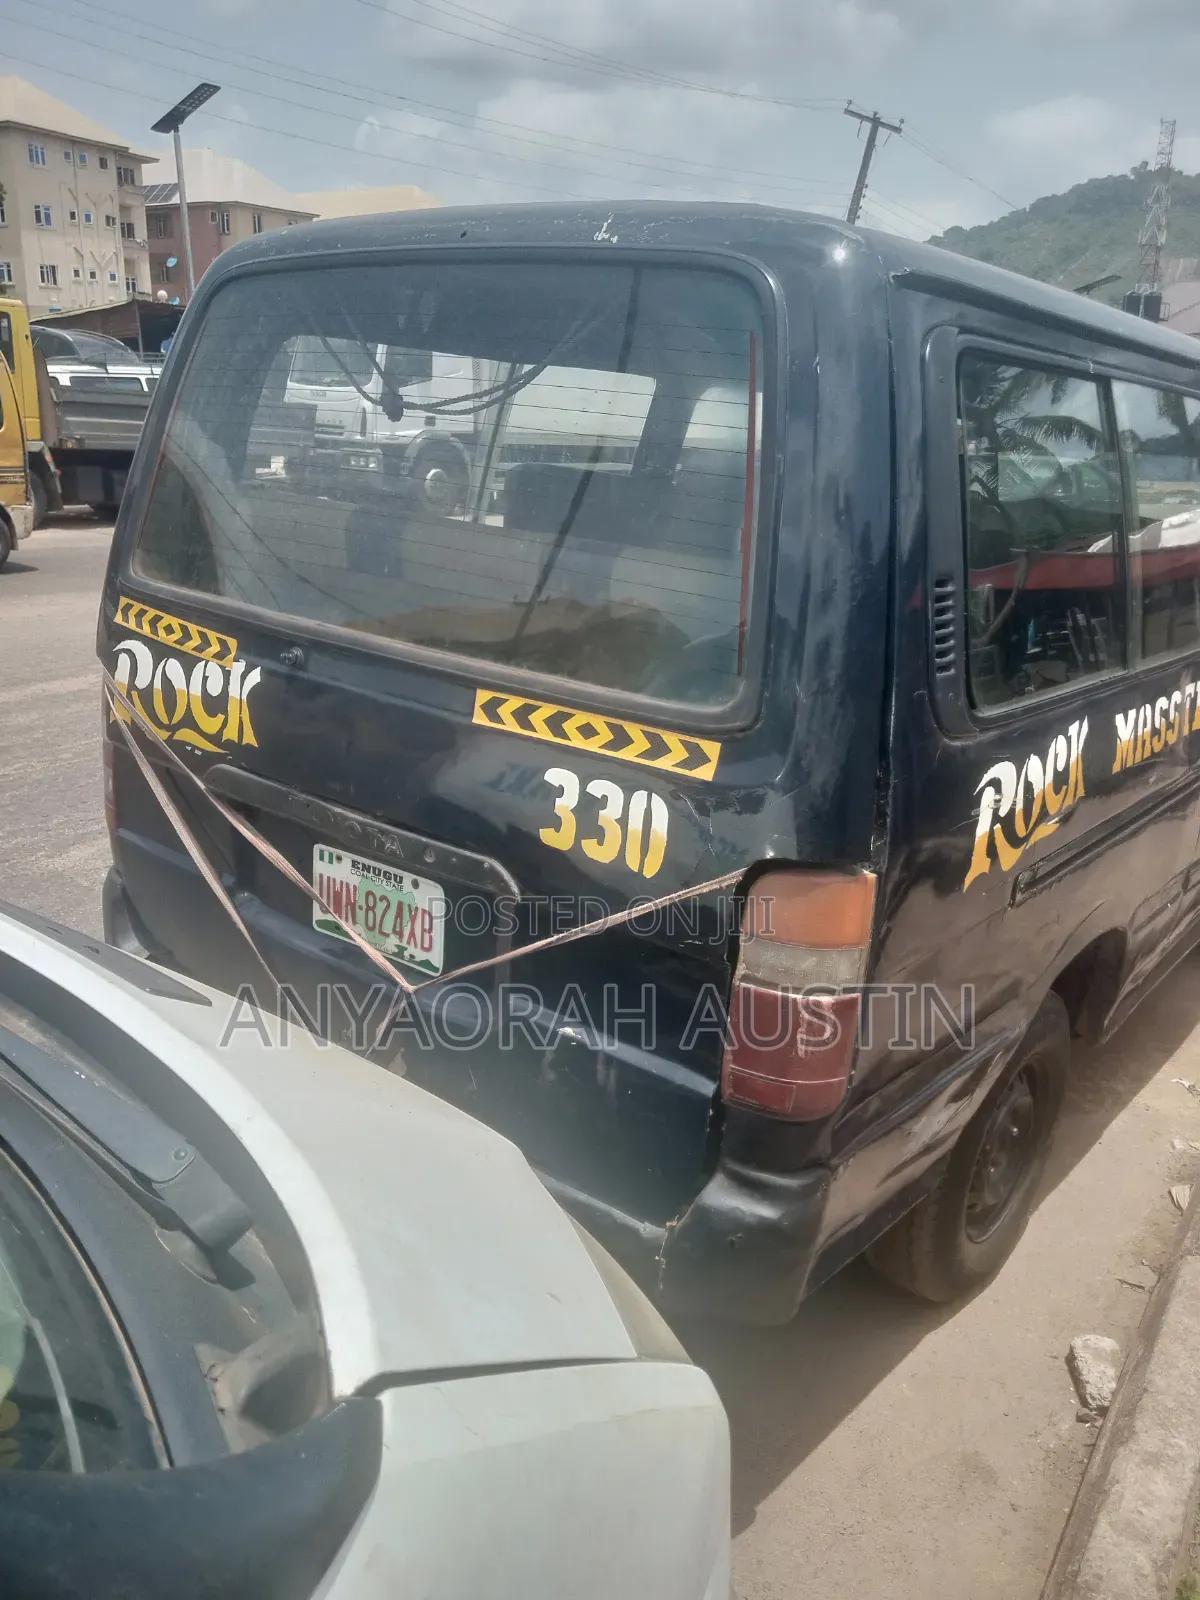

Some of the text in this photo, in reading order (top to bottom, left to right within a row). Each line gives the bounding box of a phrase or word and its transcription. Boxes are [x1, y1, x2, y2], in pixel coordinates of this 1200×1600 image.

[109, 639, 262, 753] ROCK
[539, 767, 669, 878] 330
[963, 715, 1087, 893] ROCK
[351, 859, 404, 884] ENUGU
[351, 868, 404, 892] COAL CITY STATE
